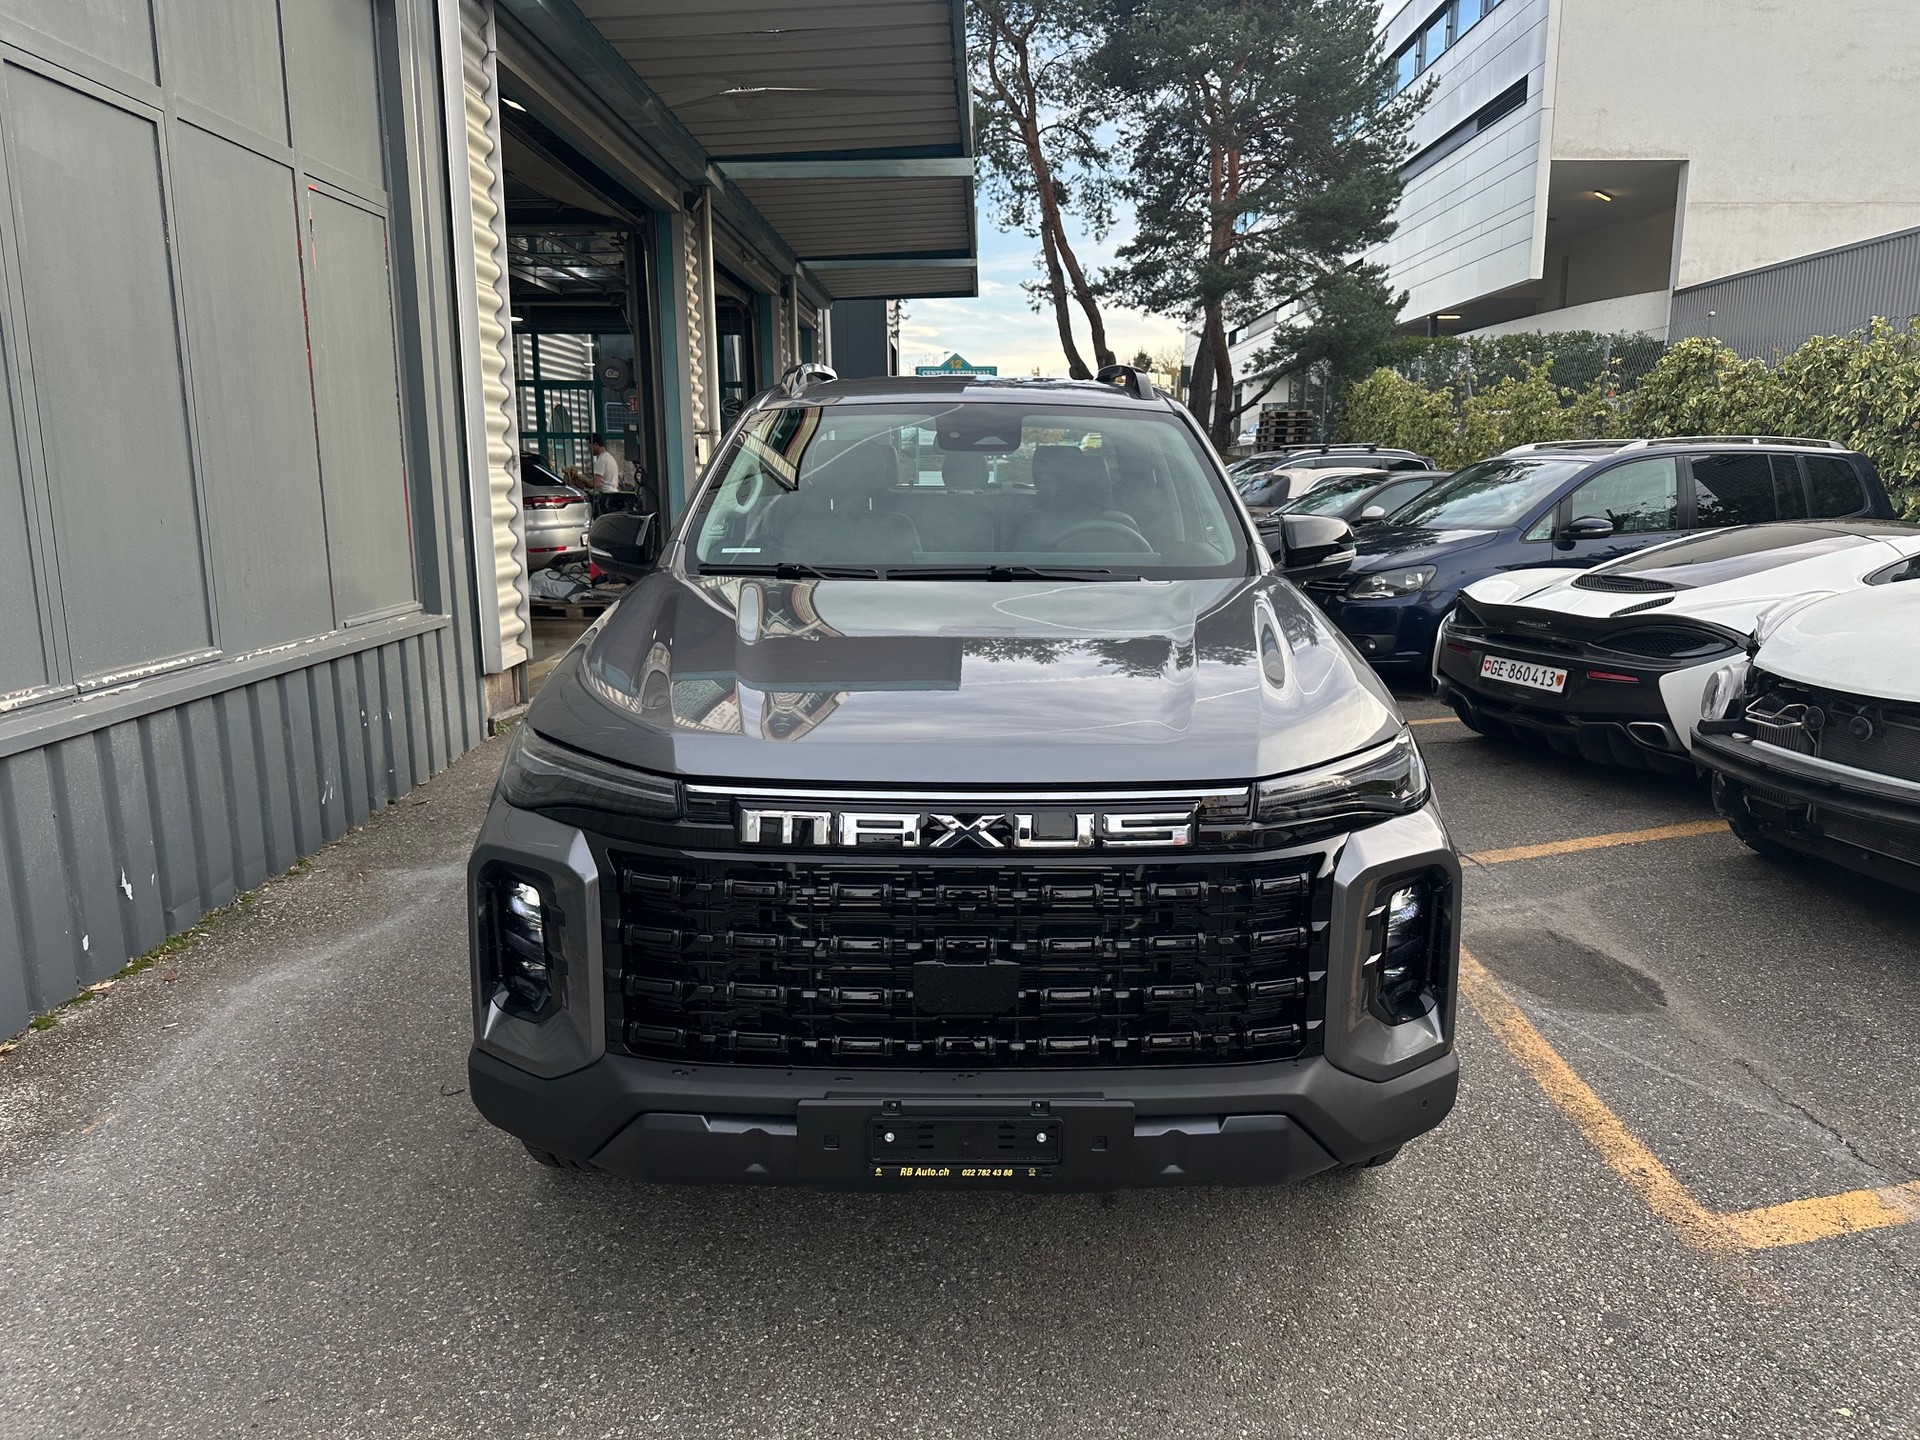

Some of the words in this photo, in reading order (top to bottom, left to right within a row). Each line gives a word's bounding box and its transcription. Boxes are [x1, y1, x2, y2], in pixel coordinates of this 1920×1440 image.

[950, 360, 962, 369] 12
[740, 808, 1197, 849] MAXUS
[900, 1167, 914, 1177] RB
[915, 1167, 950, 1177] Auto.ch
[962, 1168, 976, 1177] 022
[977, 1168, 991, 1177] 782
[992, 1168, 1002, 1177] 43
